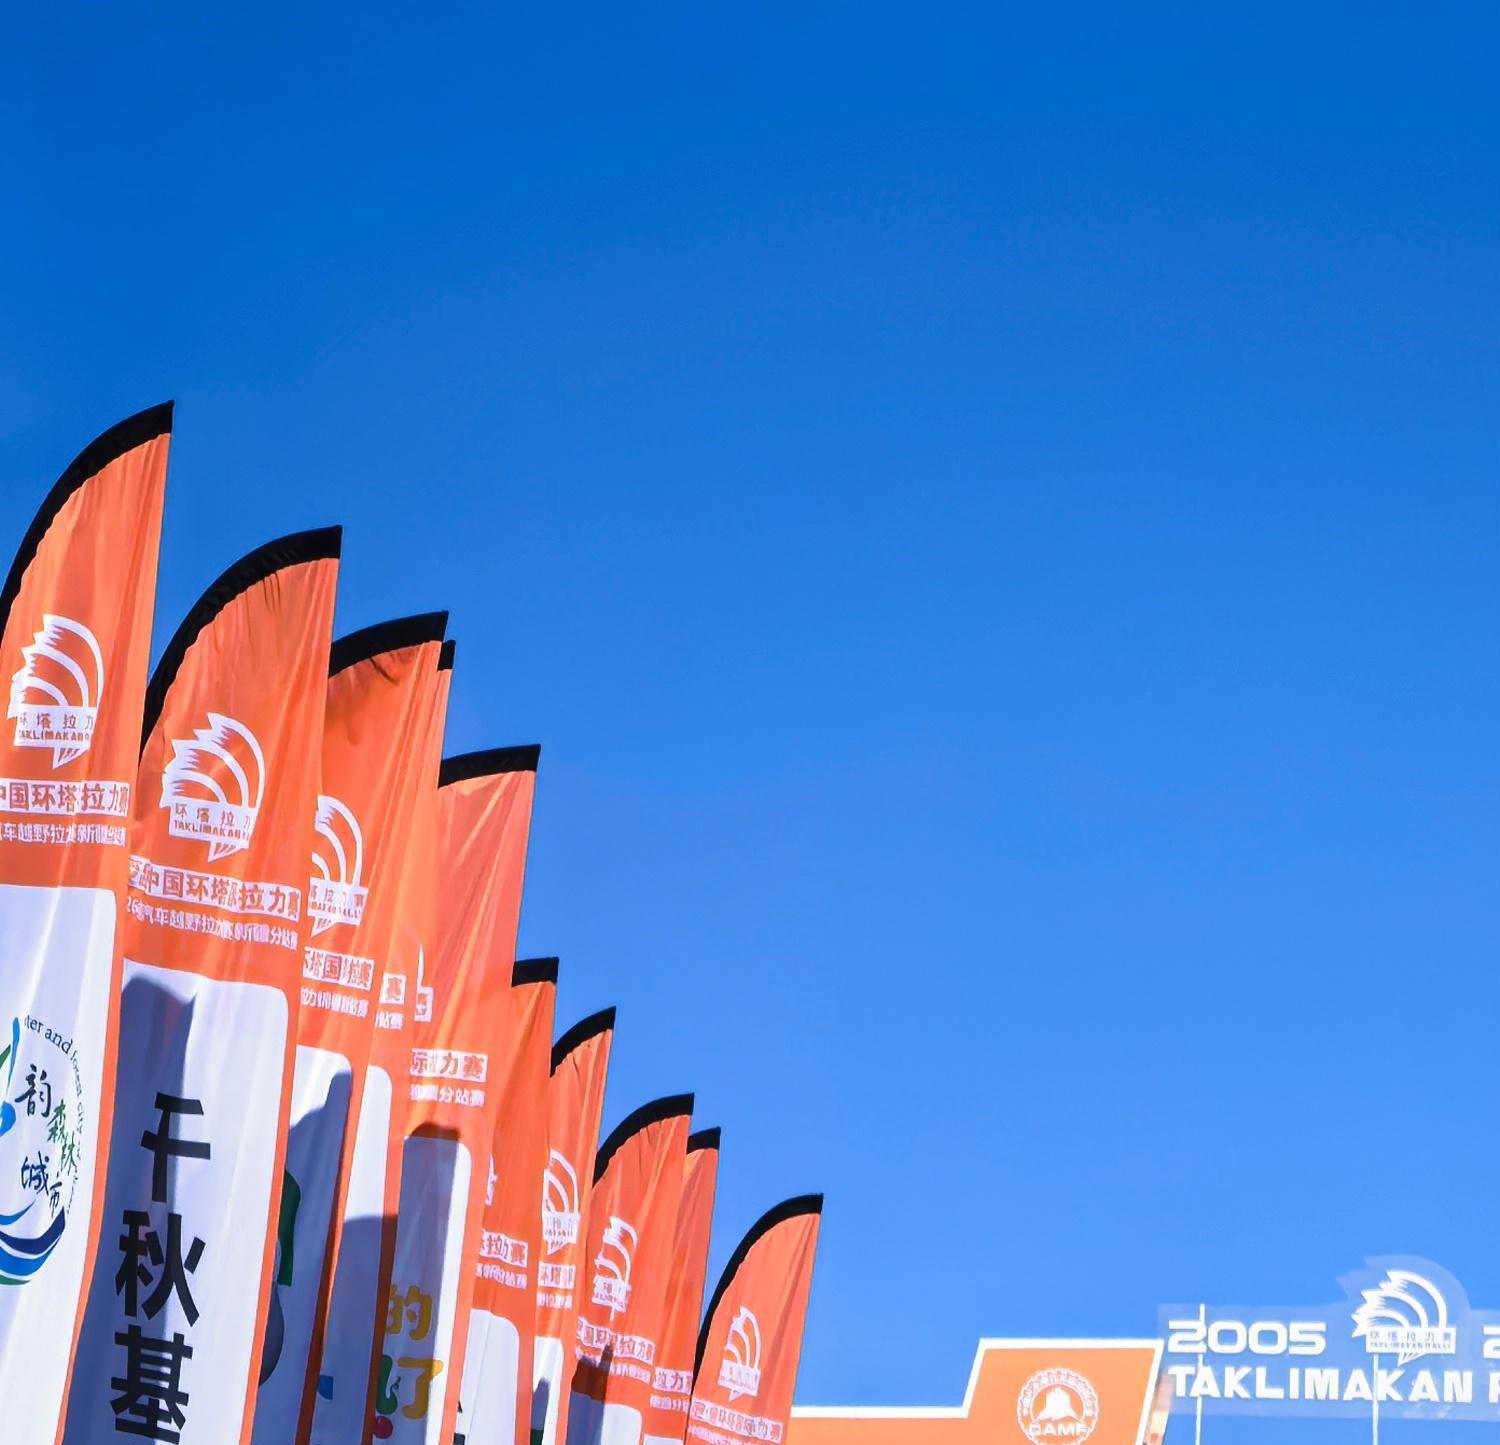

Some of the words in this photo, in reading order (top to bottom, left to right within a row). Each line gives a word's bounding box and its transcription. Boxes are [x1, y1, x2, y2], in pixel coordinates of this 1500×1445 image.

[44, 1028, 74, 1054] and
[1167, 1319, 1327, 1356] 2005
[1167, 1364, 1473, 1404] TAKLIMAKAN
